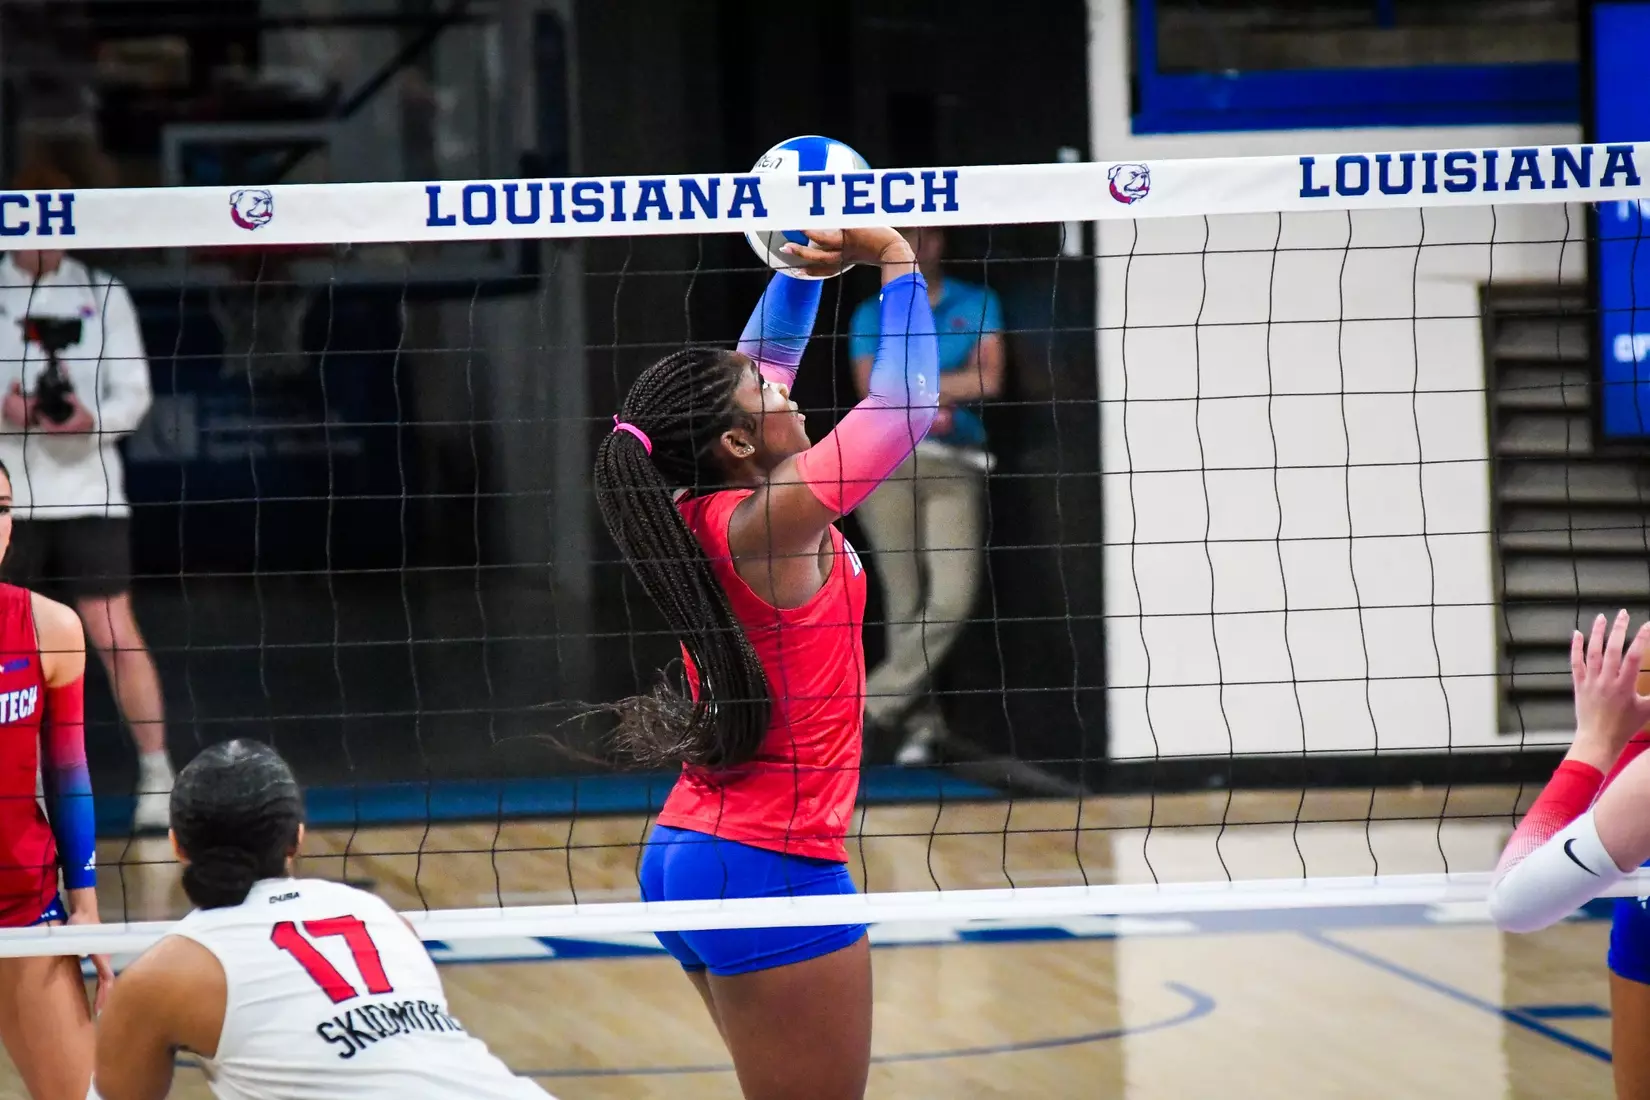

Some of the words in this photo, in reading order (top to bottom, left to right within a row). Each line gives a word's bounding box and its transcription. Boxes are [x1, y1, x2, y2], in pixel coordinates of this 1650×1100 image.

[425, 177, 768, 227] LOUISIANA
[799, 169, 959, 216] TECH
[1300, 145, 1640, 198] LOUISIANA
[0, 685, 38, 724] TECH
[270, 914, 394, 1005] 17
